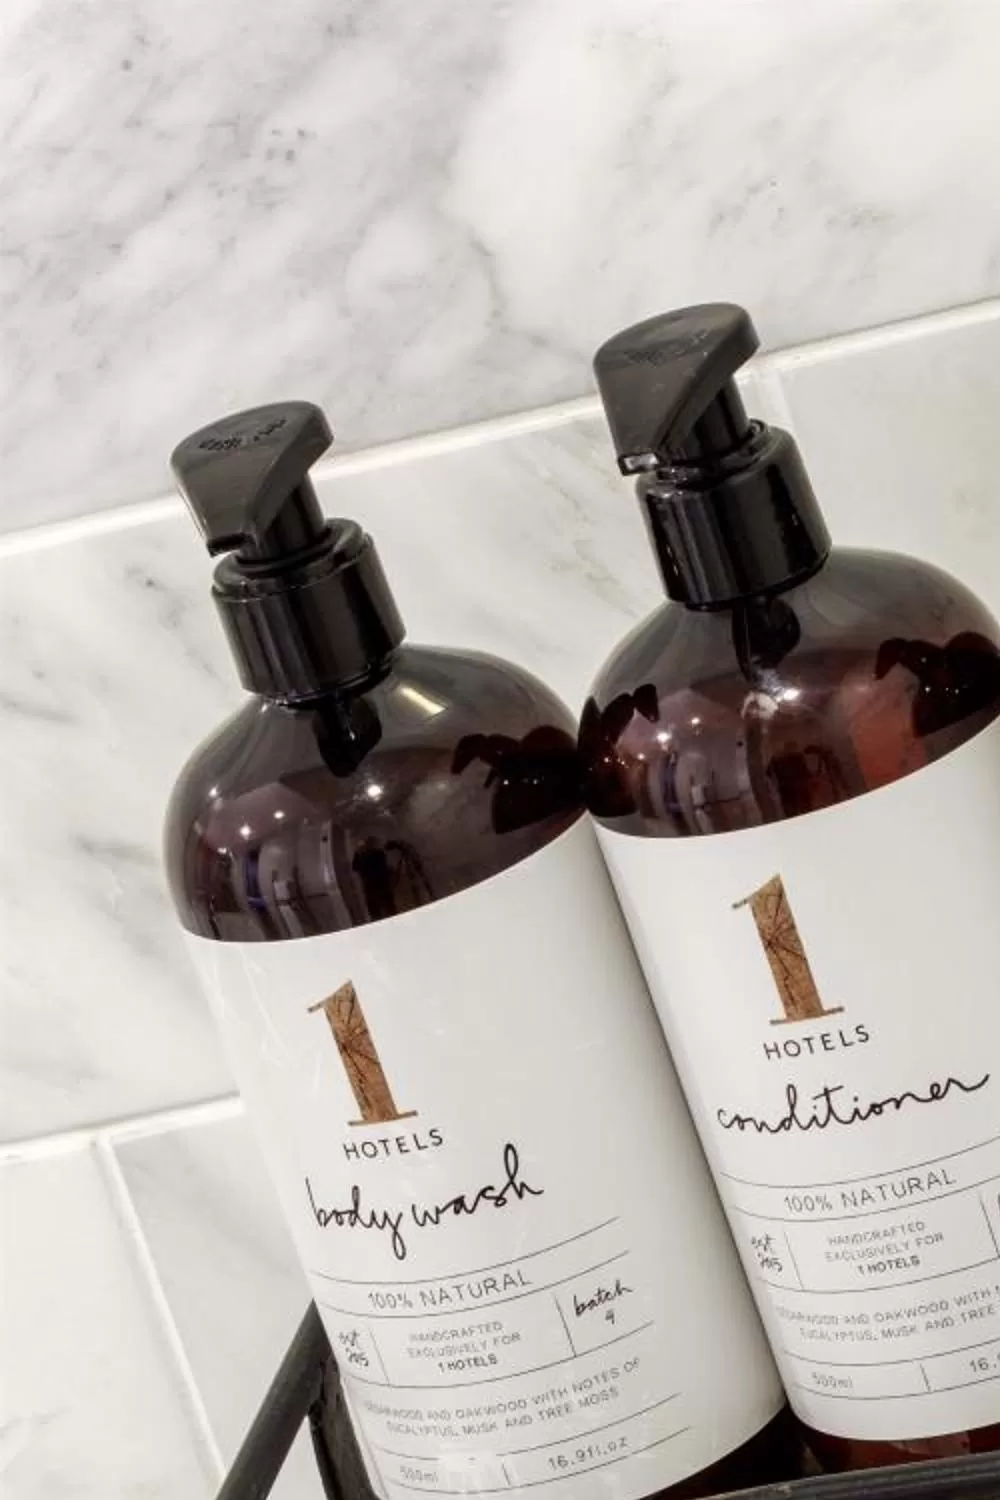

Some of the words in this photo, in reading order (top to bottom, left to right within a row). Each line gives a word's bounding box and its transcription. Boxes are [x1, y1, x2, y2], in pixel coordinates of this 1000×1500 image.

[732, 873, 844, 1025] 1
[307, 978, 418, 1126] 1
[763, 1024, 870, 1060] HOTELS
[717, 1073, 991, 1134] conditioner
[342, 1128, 444, 1160] HOTELS
[305, 1177, 407, 1260] body
[411, 1143, 545, 1227] wash
[784, 1193, 832, 1213] 100%
[841, 1168, 957, 1208] NATURAL
[825, 1239, 910, 1263] EXCLUSIVELY
[915, 1231, 945, 1250] FOR
[827, 1220, 925, 1247] HANDCRAFTED
[867, 1255, 920, 1274] HOTELS
[368, 1290, 413, 1309] 100%
[419, 1269, 532, 1307] NATURAL
[573, 1277, 633, 1316] batch
[873, 1299, 949, 1323] OAKWOOD
[955, 1288, 992, 1310] WITH
[409, 1320, 504, 1344] HANDCRAFTED
[925, 1313, 955, 1332] AND
[960, 1304, 995, 1324] TREE
[407, 1338, 488, 1359] EXCLUSIVELY
[496, 1331, 521, 1347] FOR
[446, 1353, 498, 1372] HOTELS
[455, 1398, 527, 1420] OAKWOOD
[533, 1384, 569, 1406] WITH
[572, 1367, 620, 1394] NOTES
[623, 1356, 641, 1375] OF
[504, 1413, 533, 1432] AND
[539, 1402, 573, 1421] TREE
[577, 1386, 619, 1409] MOSS
